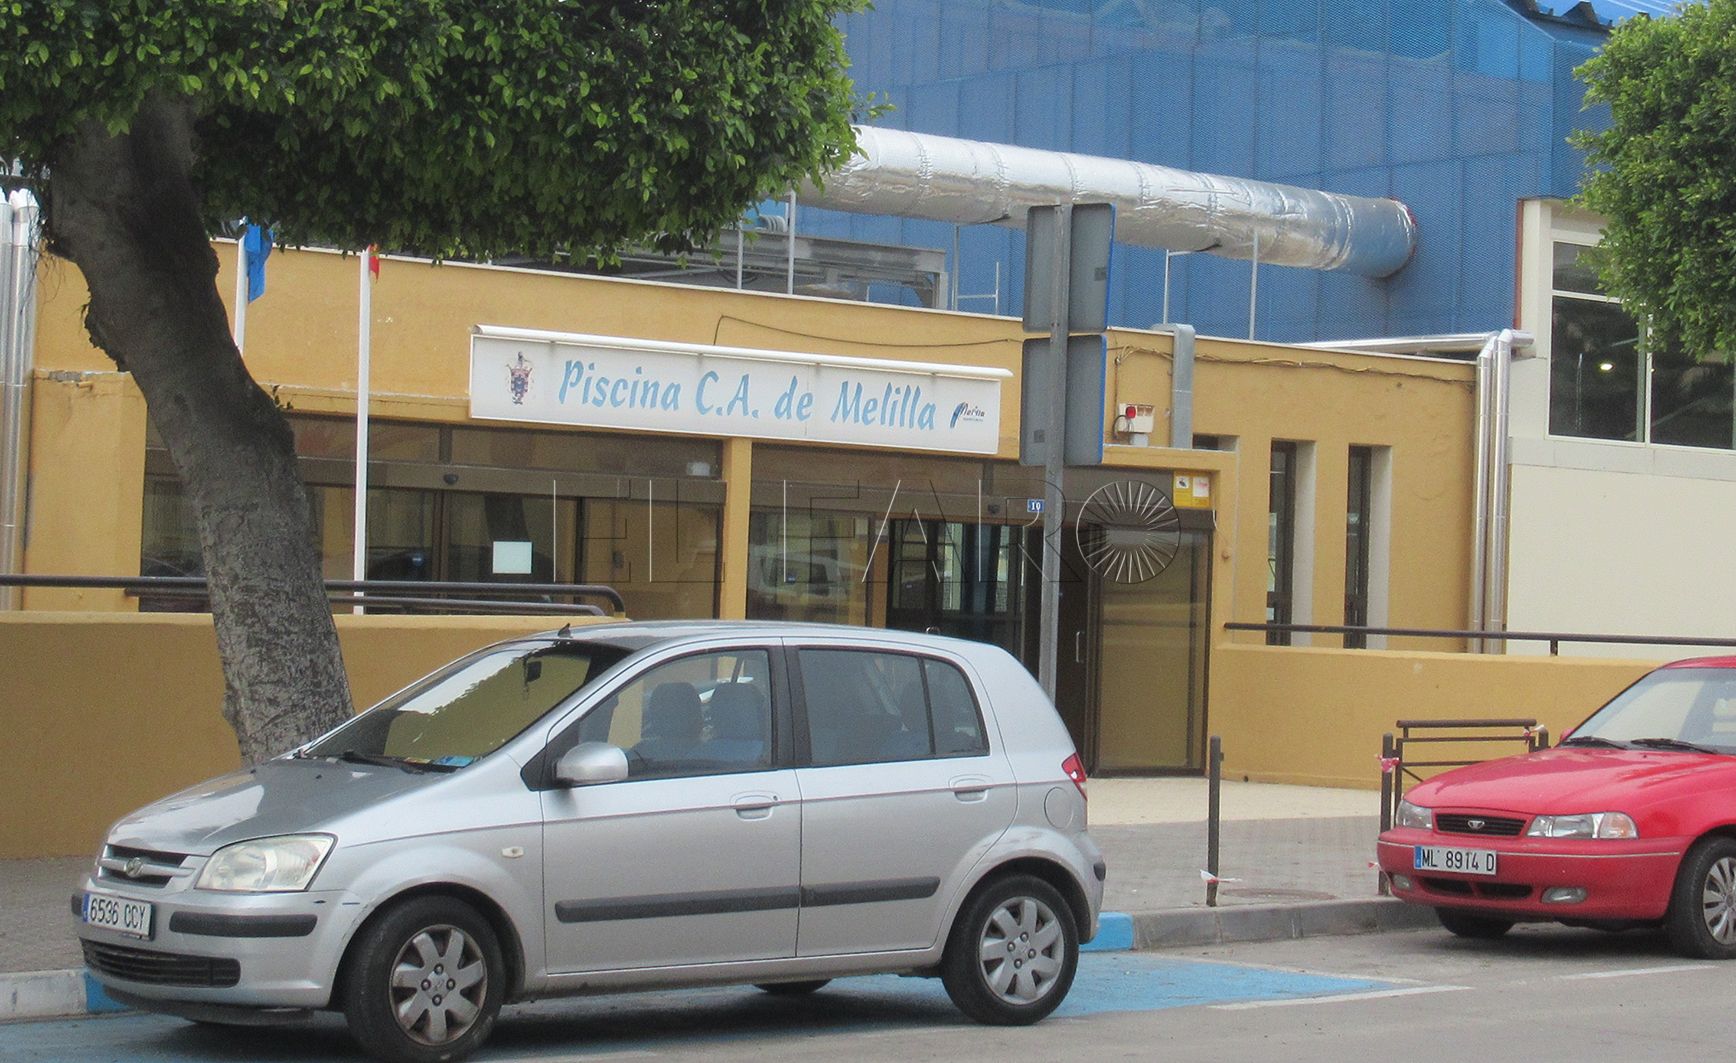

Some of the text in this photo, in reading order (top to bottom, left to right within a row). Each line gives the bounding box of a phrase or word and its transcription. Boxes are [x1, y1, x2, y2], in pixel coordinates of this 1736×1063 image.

[558, 359, 936, 430] Piscina C.A. de Melilla
[1031, 501, 1041, 511] 10
[1422, 849, 1495, 872] ML 8914 D
[90, 898, 146, 930] 6536 CCY
